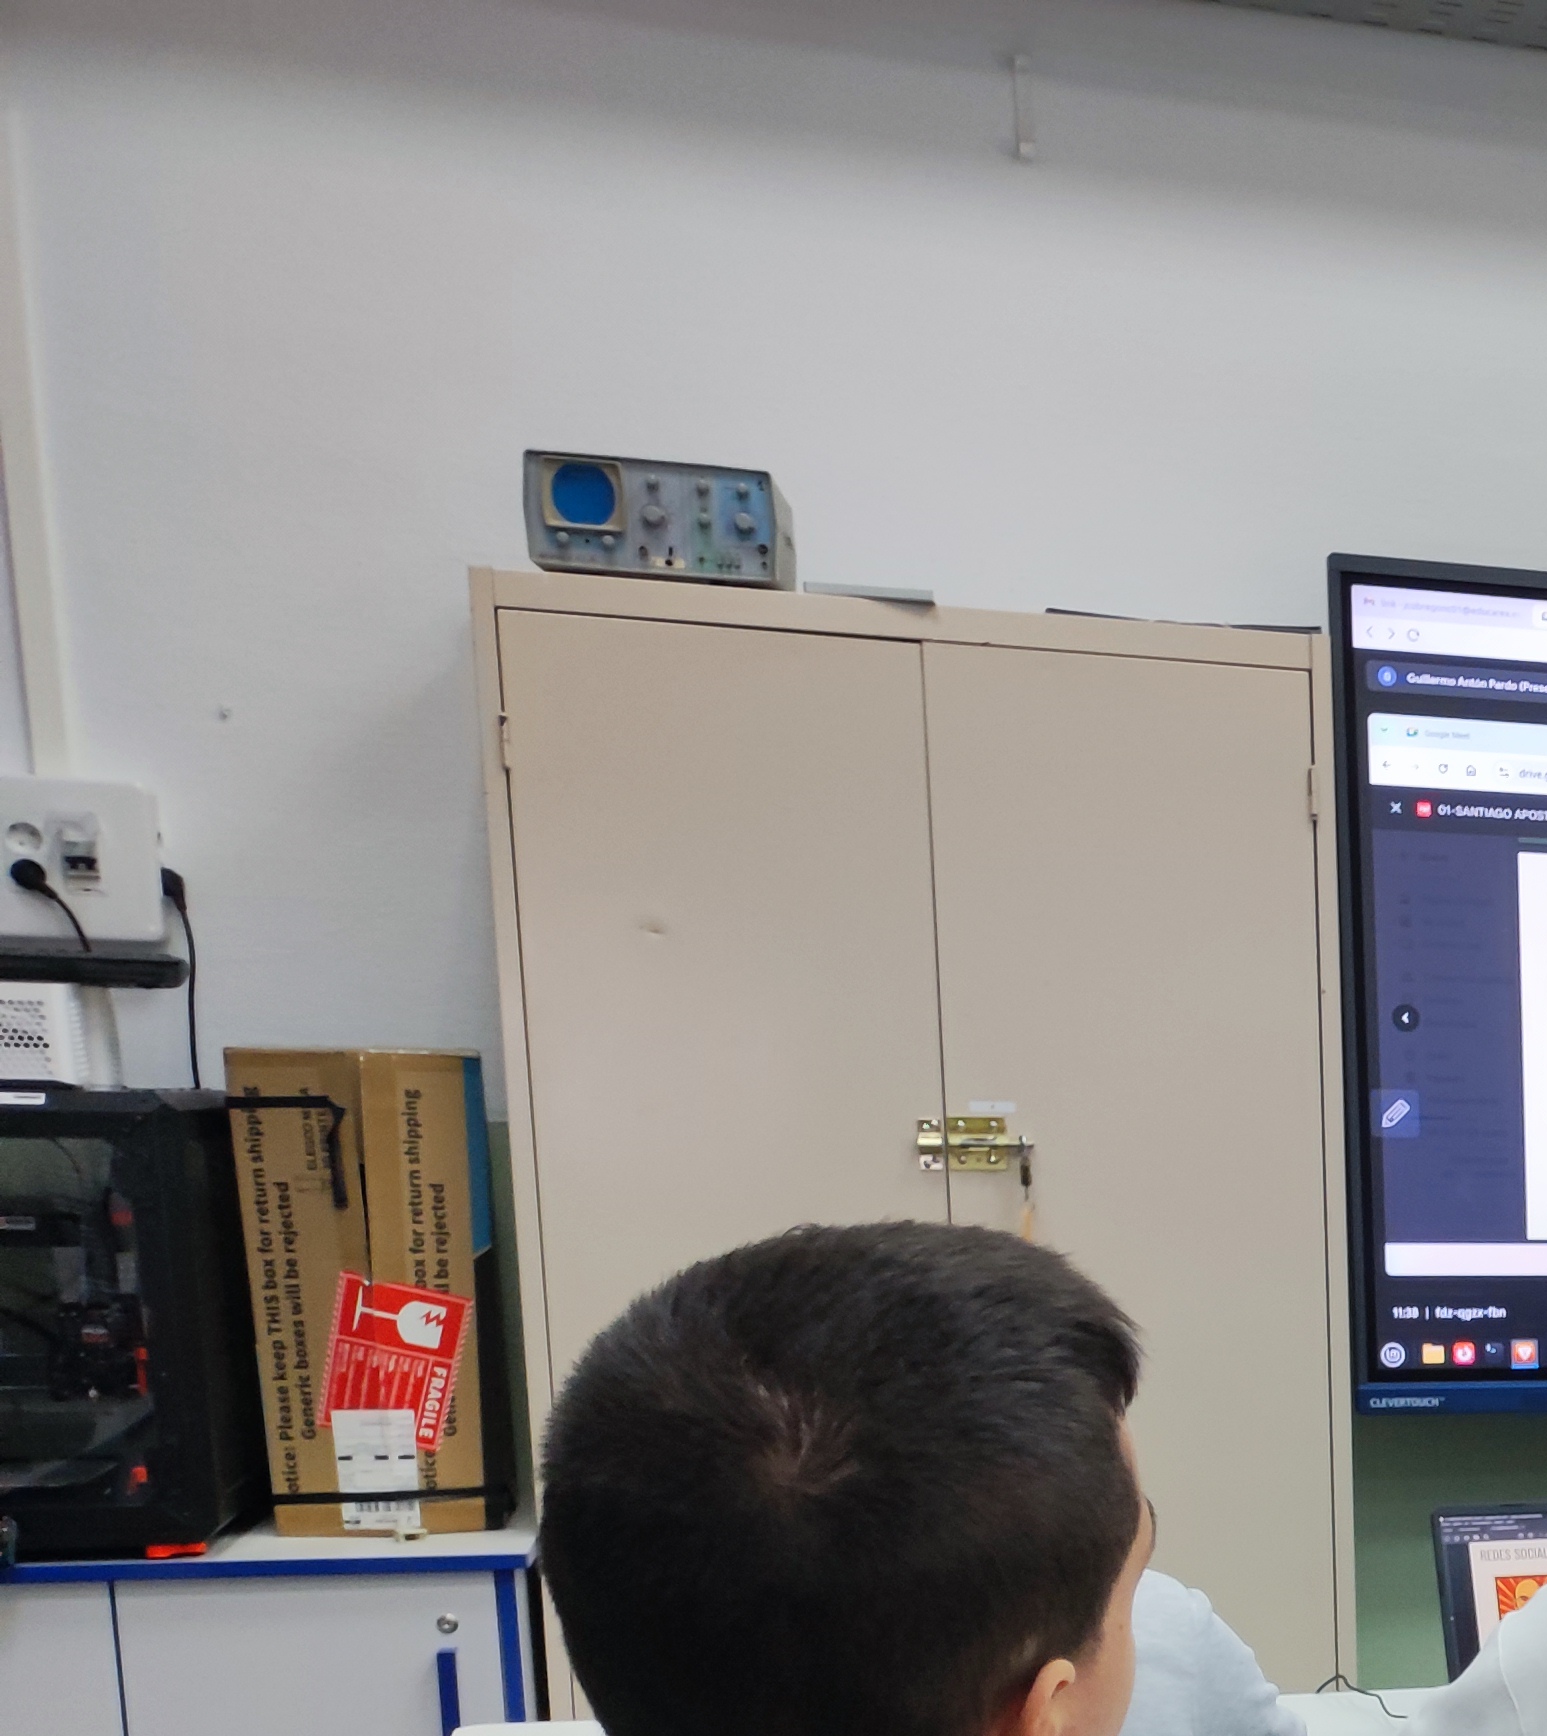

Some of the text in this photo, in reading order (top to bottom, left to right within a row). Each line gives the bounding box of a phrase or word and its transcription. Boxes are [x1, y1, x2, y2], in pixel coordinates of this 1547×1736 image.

[1406, 672, 1457, 687] Guillermo
[1488, 678, 1518, 692] Pardo
[1437, 803, 1512, 820] 01-SANTIAGO
[401, 1088, 423, 1165] shipping
[253, 1169, 269, 1224] return
[408, 1169, 423, 1225] return
[429, 1183, 451, 1253] rejected
[257, 1229, 273, 1254] for
[409, 1229, 425, 1254] for
[262, 1259, 278, 1290] box
[434, 1259, 449, 1280] be
[265, 1297, 282, 1337] THIS
[273, 1181, 316, 1440] Generic boxes will be rejected
[272, 1340, 289, 1381] keep
[276, 1387, 294, 1441] Please
[418, 1366, 447, 1439] FRAGILE
[1370, 1397, 1439, 1408] CLEVERTOUCH
[281, 1443, 300, 1494] otice:
[1480, 1548, 1511, 1562] REDES
